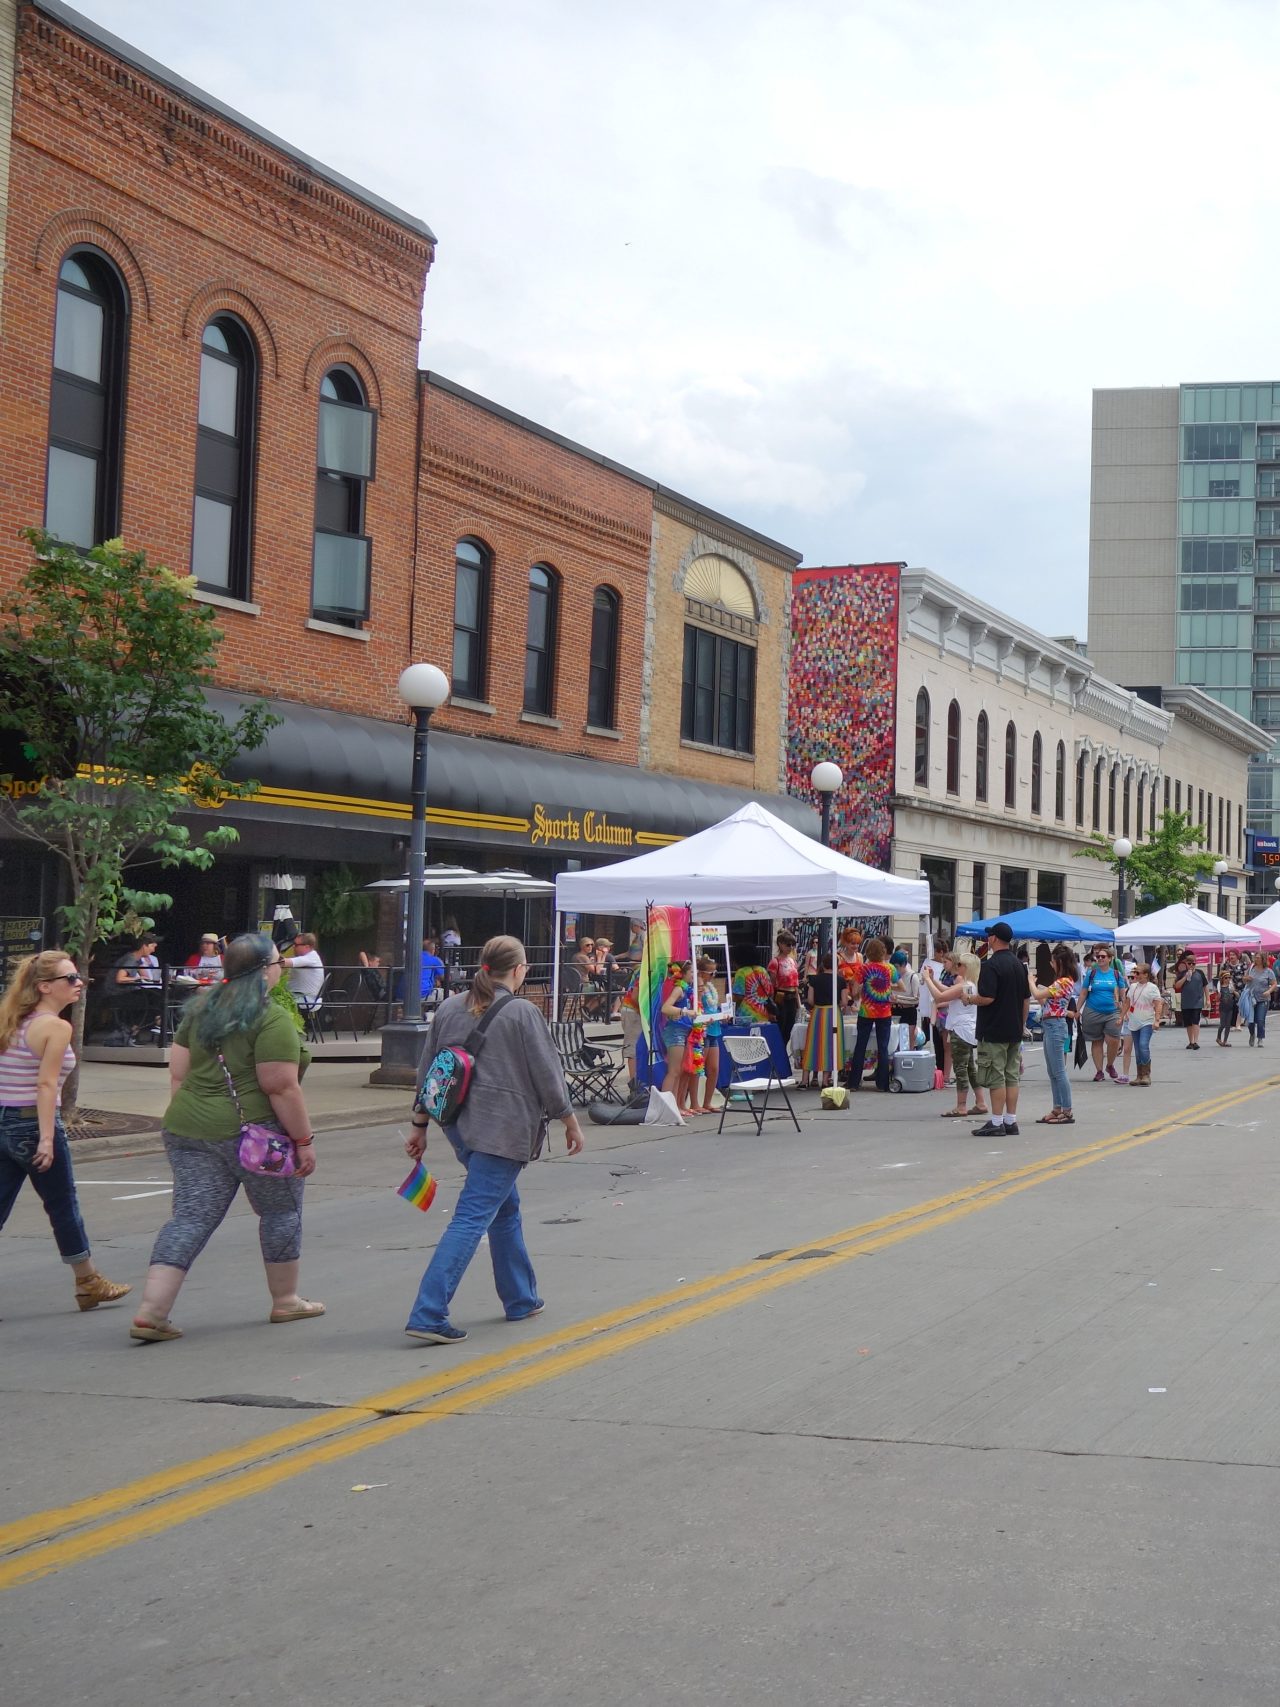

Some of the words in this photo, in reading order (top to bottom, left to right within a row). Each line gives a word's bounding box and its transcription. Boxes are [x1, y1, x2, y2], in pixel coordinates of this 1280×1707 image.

[532, 803, 580, 845] Sports
[583, 810, 633, 847] Column
[7, 920, 40, 931] HAPPY
[702, 927, 719, 942] PRIDE
